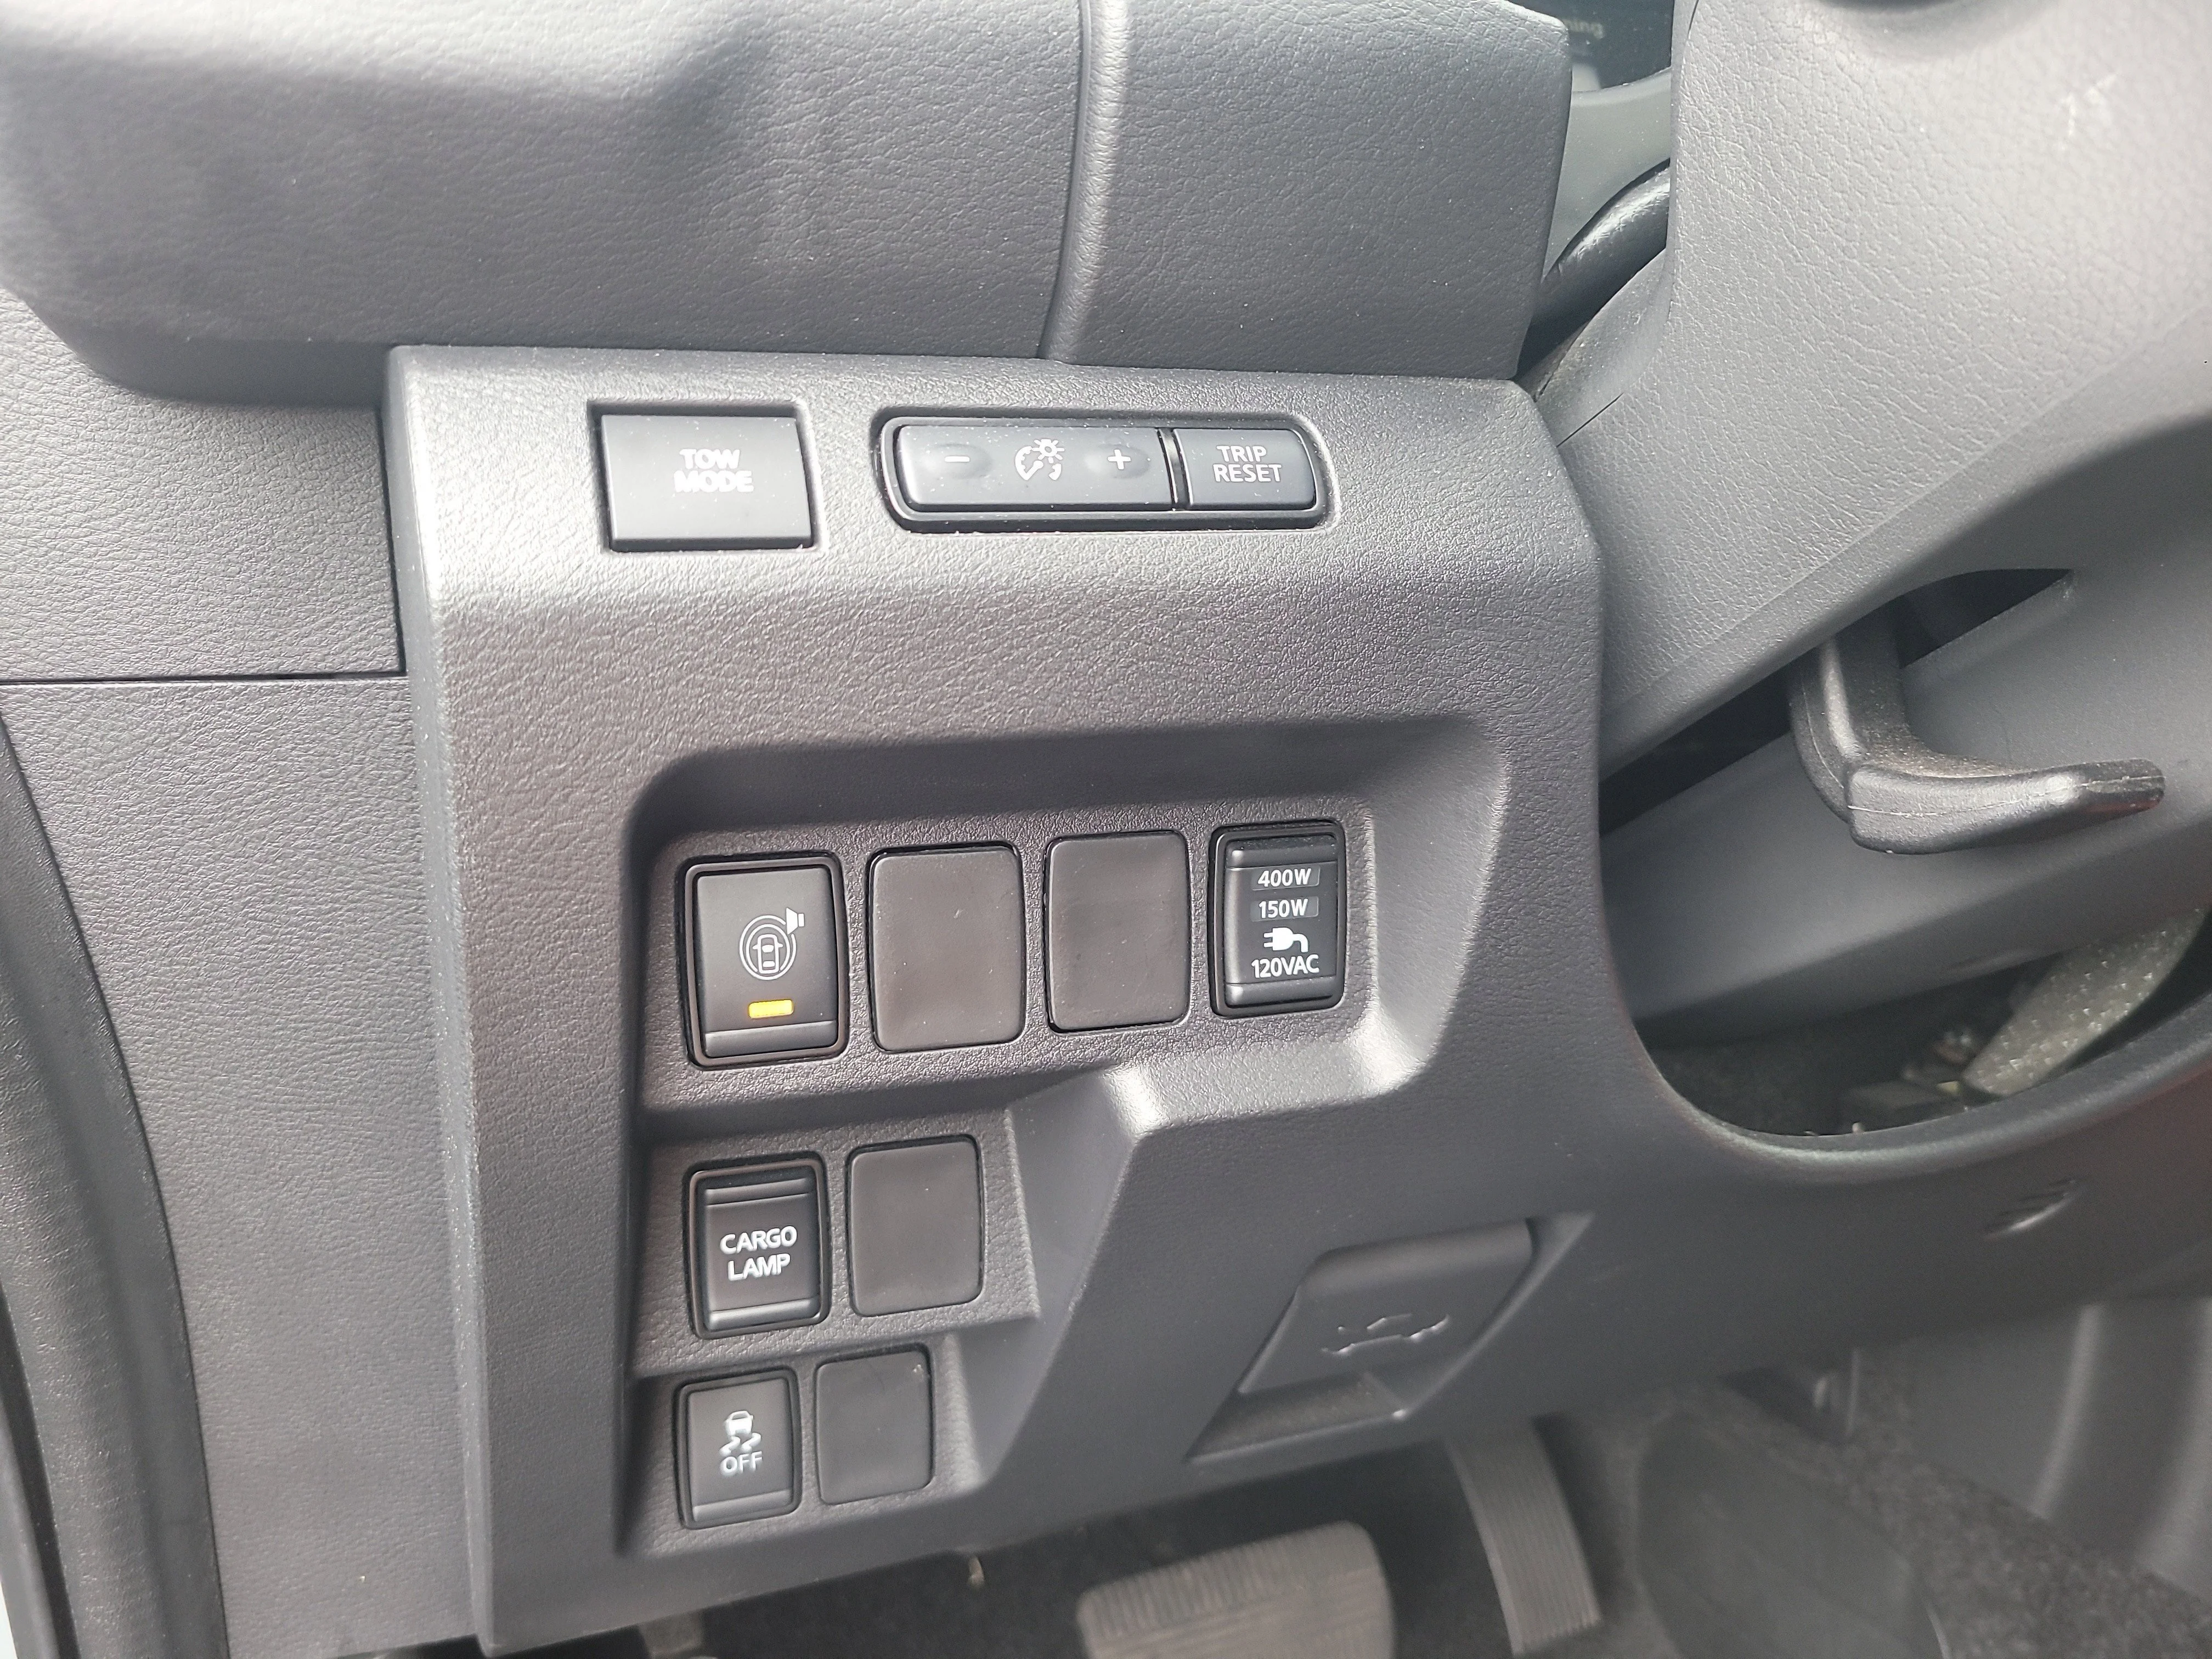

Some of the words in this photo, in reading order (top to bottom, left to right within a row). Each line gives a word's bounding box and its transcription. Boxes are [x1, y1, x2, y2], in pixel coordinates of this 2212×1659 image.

[679, 448, 740, 470] TOW
[1216, 445, 1267, 462] TRIP
[673, 470, 754, 492] MODE
[1213, 463, 1283, 482] RESET
[1257, 868, 1312, 887] 400W
[1259, 898, 1308, 918] 150W
[1251, 954, 1320, 978] 120VAC
[720, 1226, 797, 1255] CARGO
[727, 1253, 791, 1281] LAMP
[720, 1451, 763, 1476] OFF
